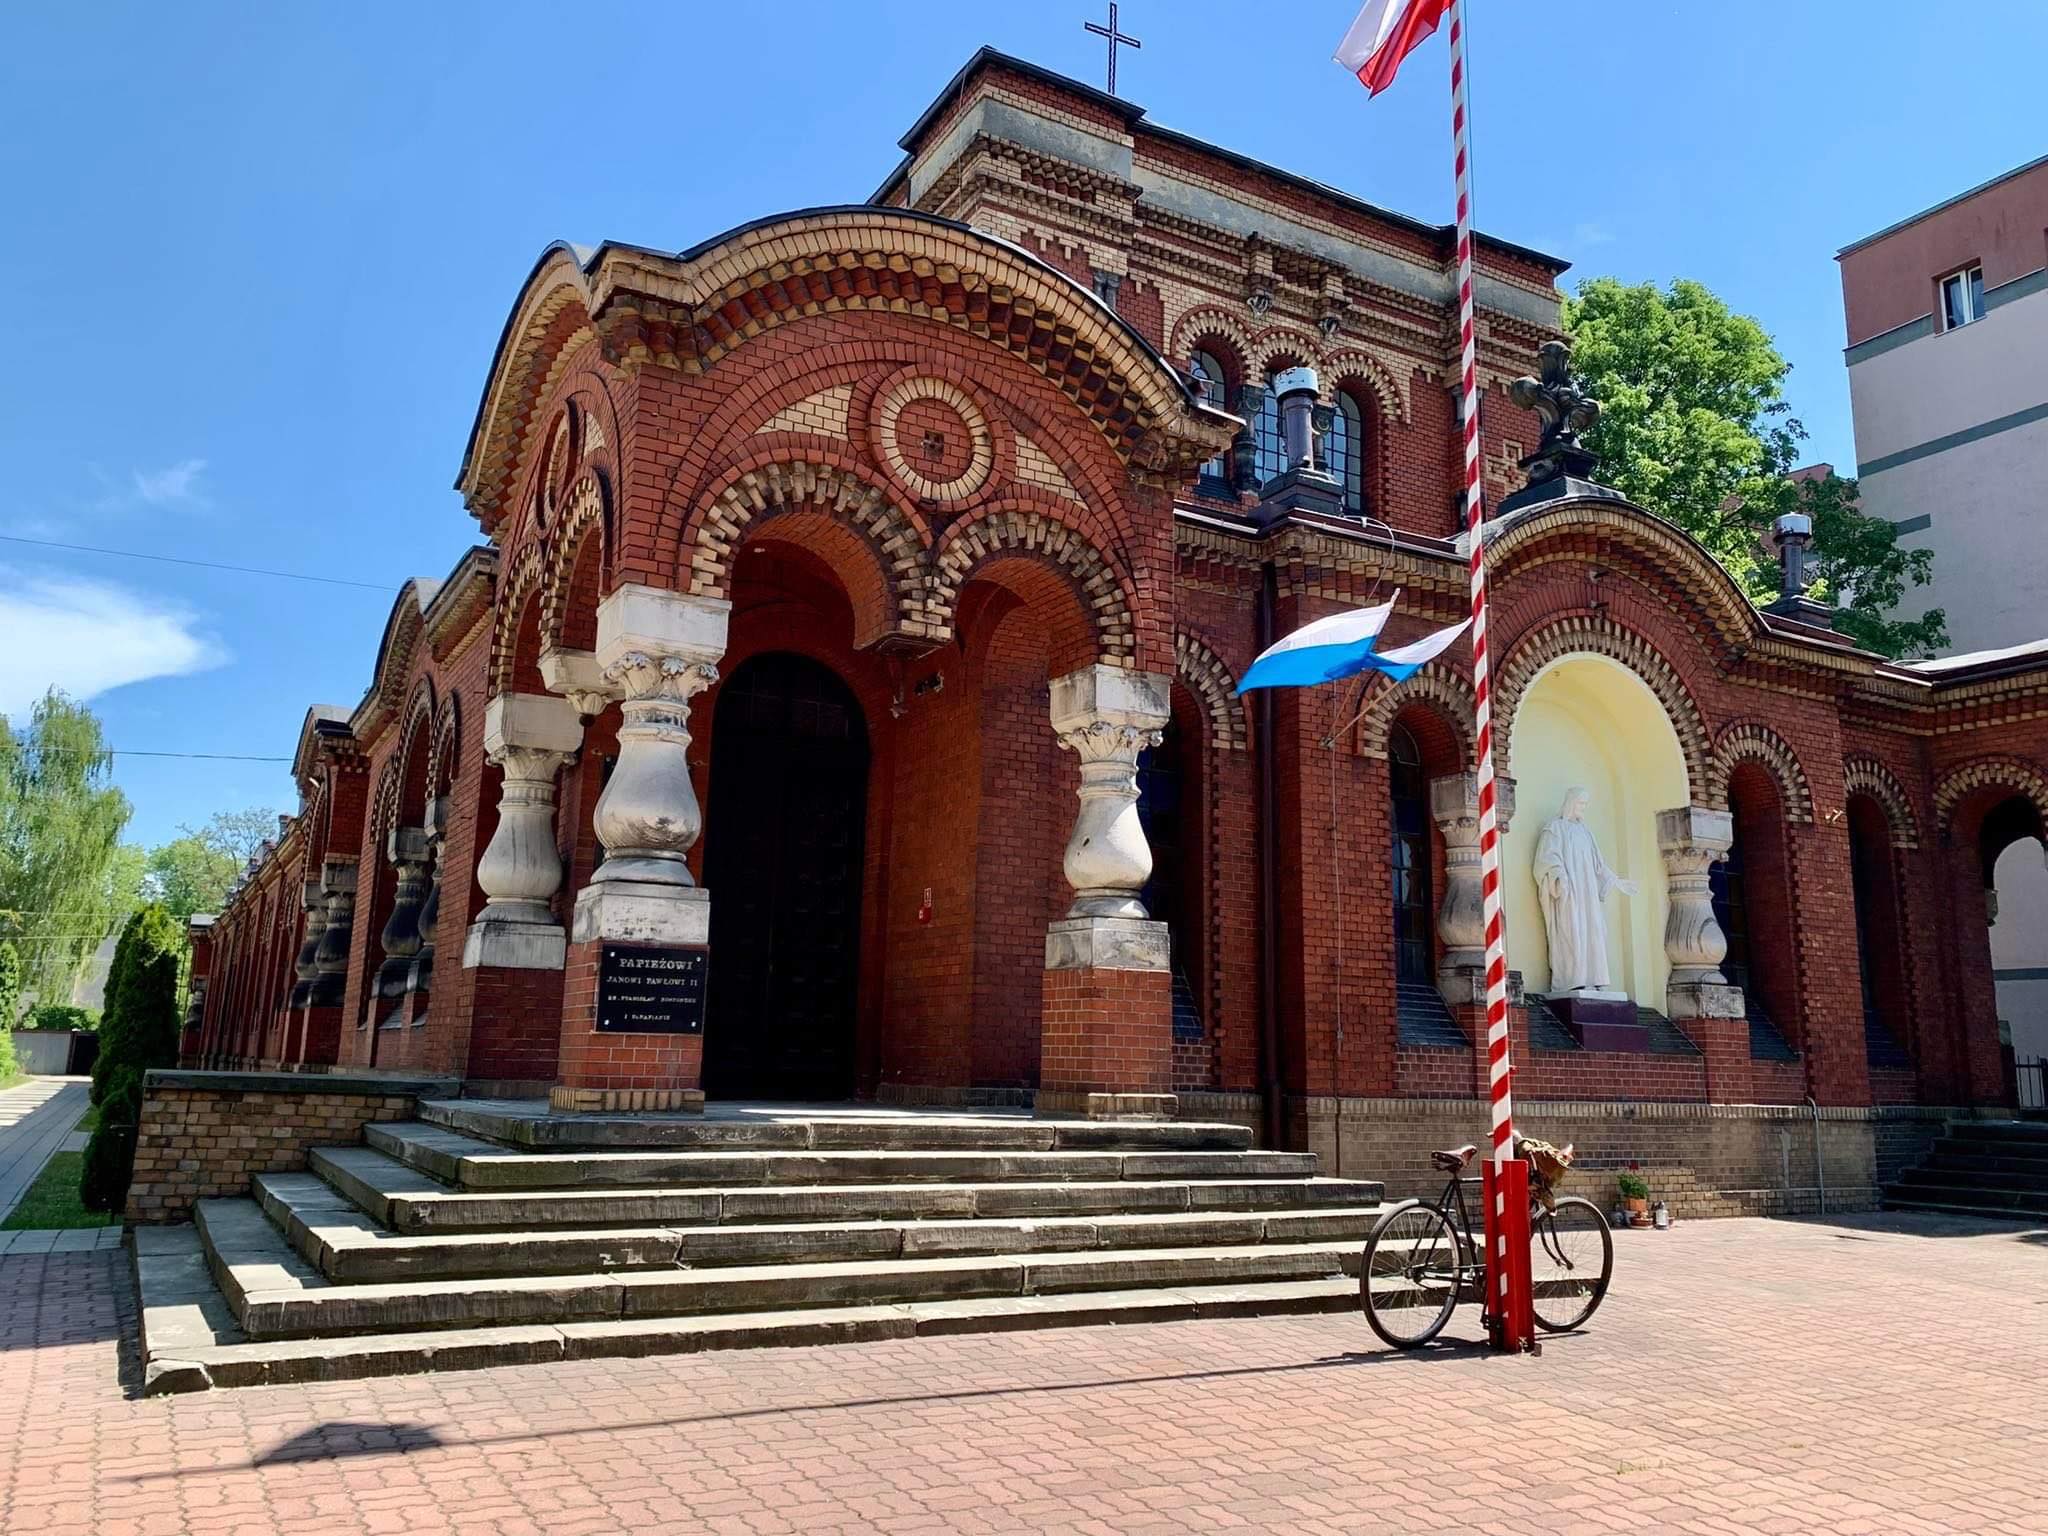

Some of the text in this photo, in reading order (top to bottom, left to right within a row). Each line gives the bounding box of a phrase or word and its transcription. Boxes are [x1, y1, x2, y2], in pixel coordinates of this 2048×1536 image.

[619, 958, 693, 970] PAPIEŻOWI
[606, 976, 698, 987] JANOWI PAWŁOWI II
